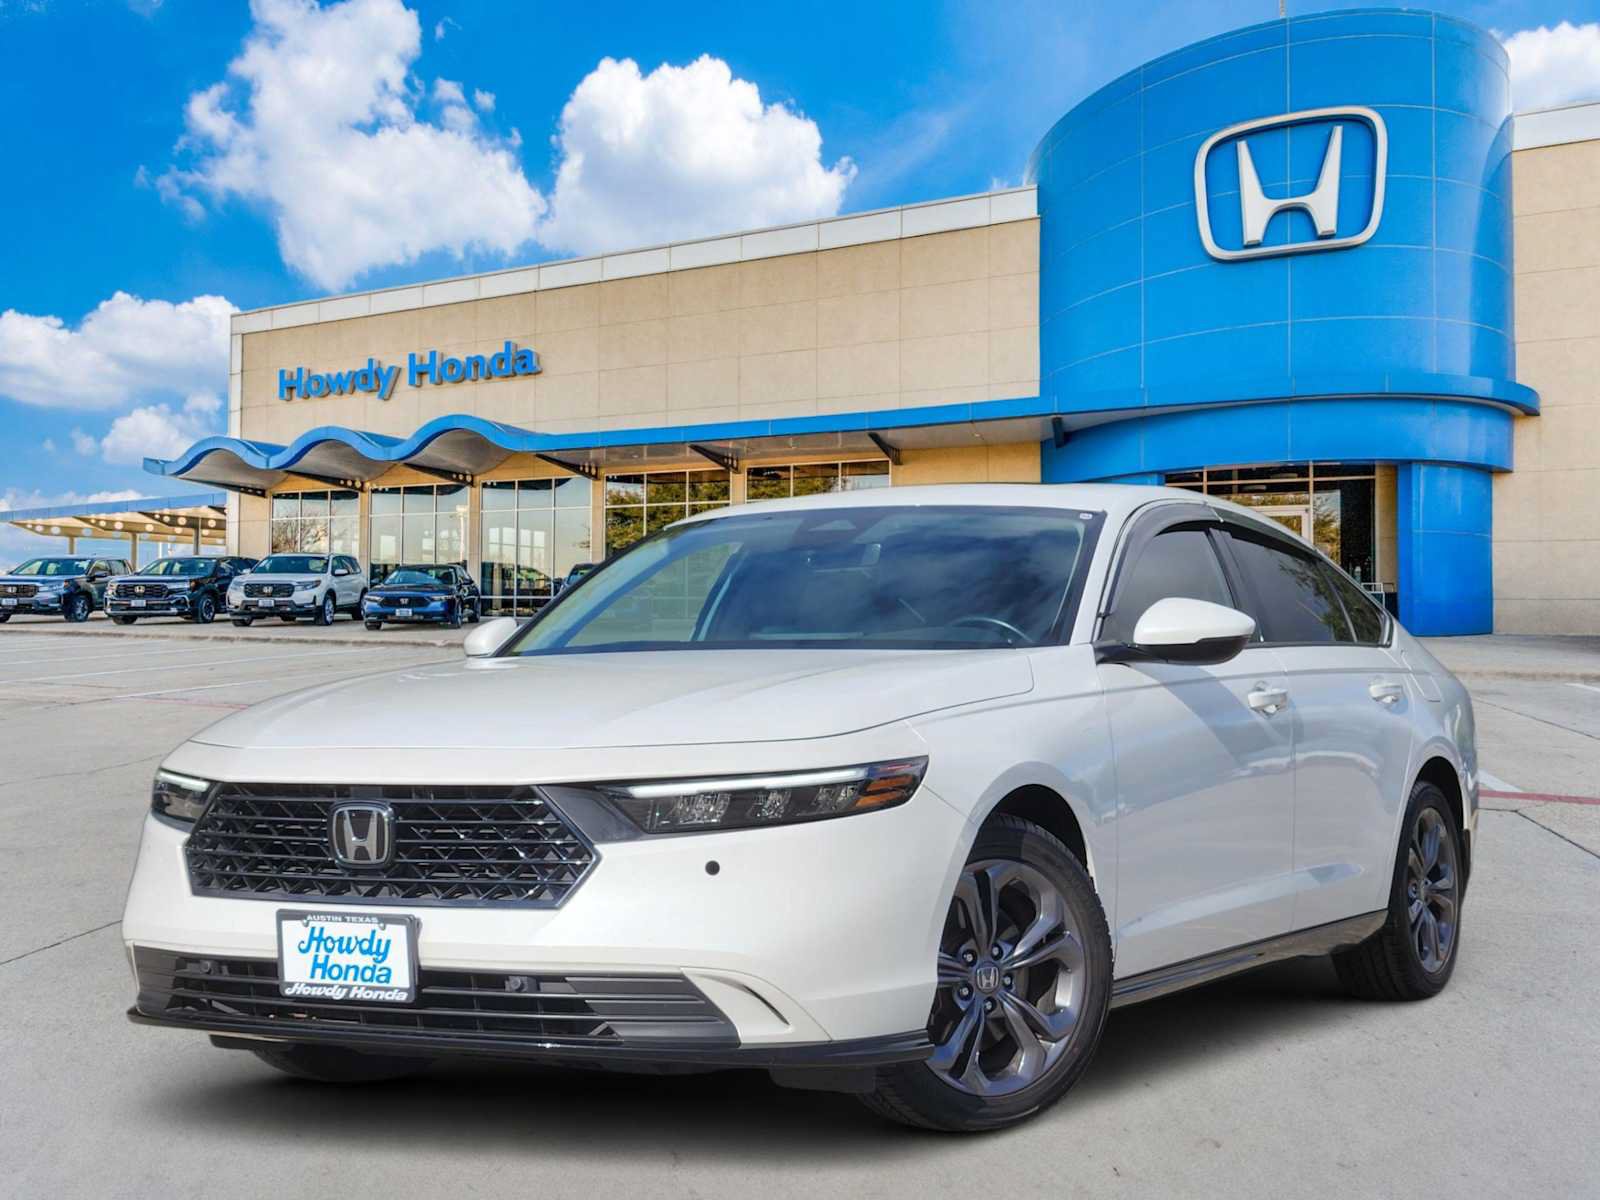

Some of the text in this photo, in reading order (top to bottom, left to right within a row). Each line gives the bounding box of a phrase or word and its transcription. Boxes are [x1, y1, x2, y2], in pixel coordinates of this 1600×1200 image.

[278, 341, 541, 401] Howdy Honda
[306, 914, 379, 924] AUSTIN TEXAS
[298, 926, 391, 963] Howdy
[310, 954, 392, 984] Honda
[284, 982, 408, 1001] Howdy Honda
